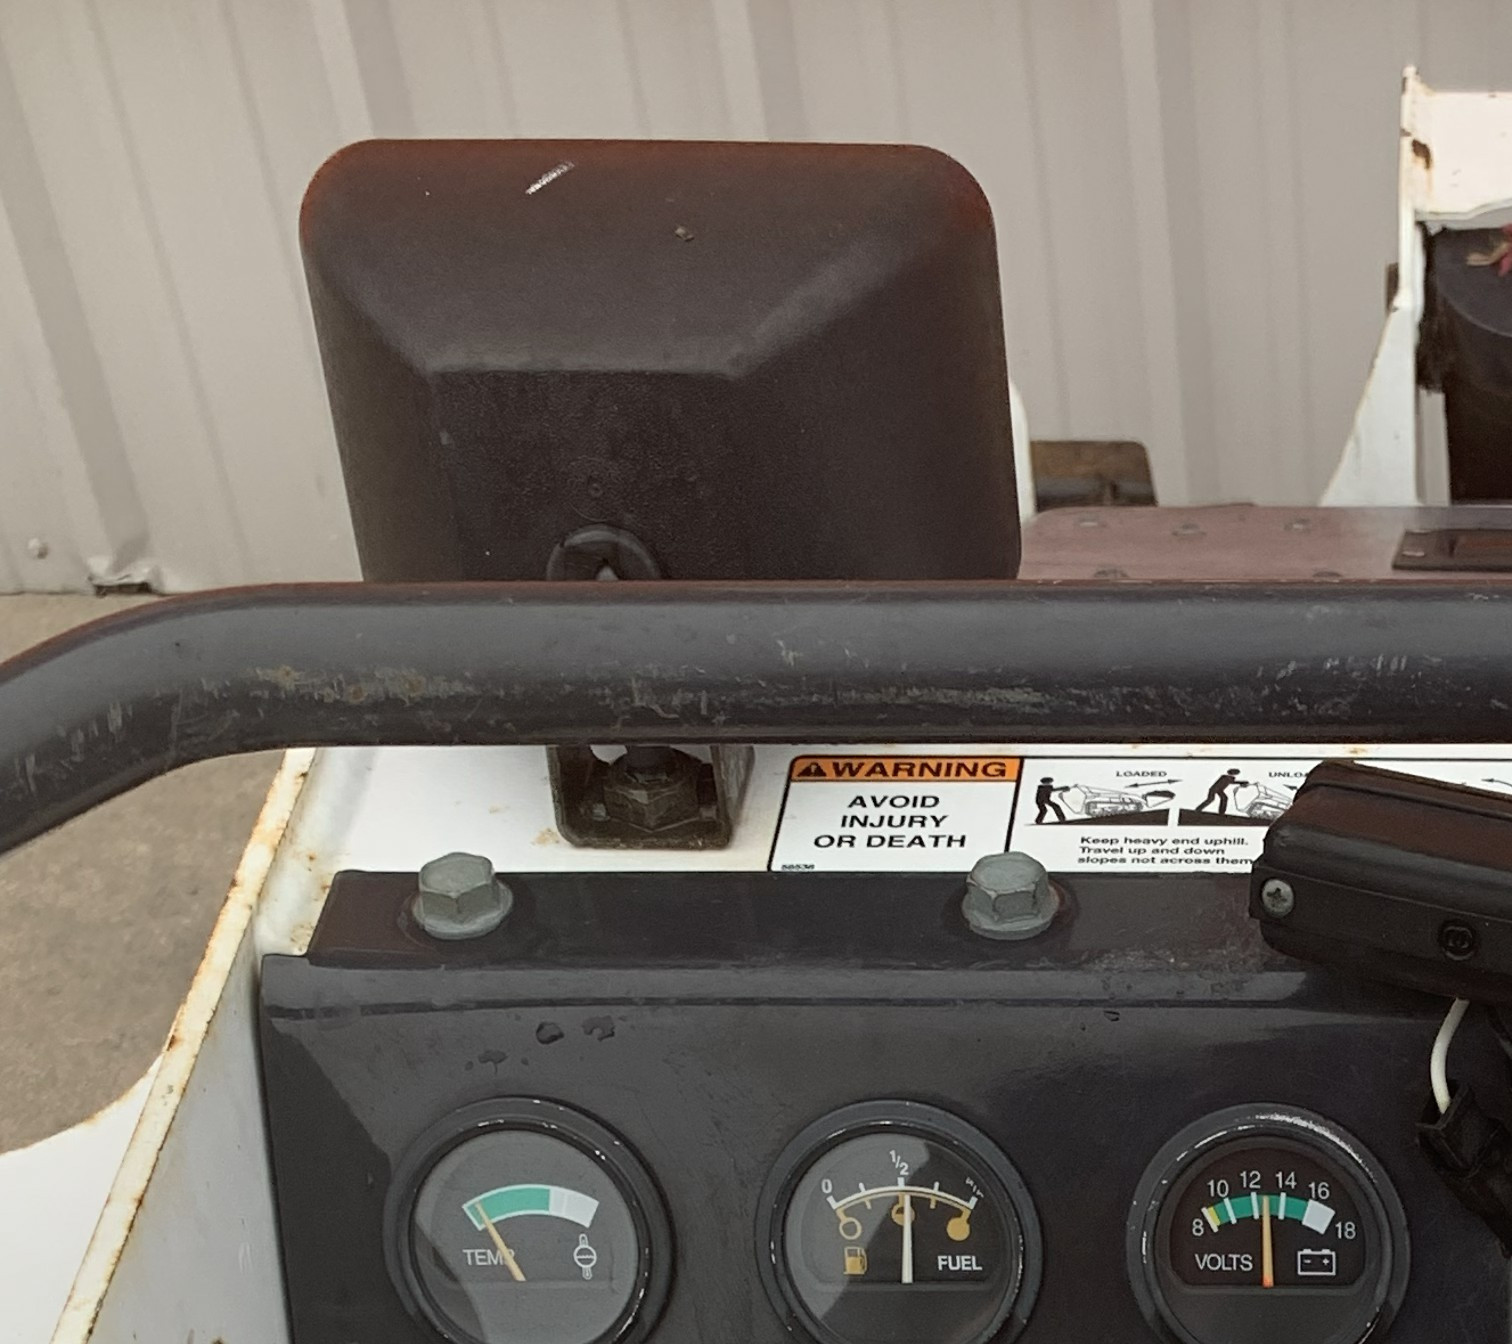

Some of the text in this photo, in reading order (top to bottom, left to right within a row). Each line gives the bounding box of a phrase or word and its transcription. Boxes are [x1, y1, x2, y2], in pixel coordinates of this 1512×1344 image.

[832, 761, 1007, 778] WARNING
[1115, 770, 1168, 778] LOADED
[848, 795, 940, 808] AVOID
[840, 815, 949, 828] INJURY
[813, 834, 967, 848] OR DEATH
[1080, 836, 1249, 846] Keep heavy end uphill.
[1207, 1171, 1330, 1200] 10 12 14 16
[1192, 1218, 1204, 1236] 8
[1335, 1222, 1356, 1240] 18
[937, 1255, 983, 1271] FUEL
[1195, 1253, 1253, 1271] VOLTS
